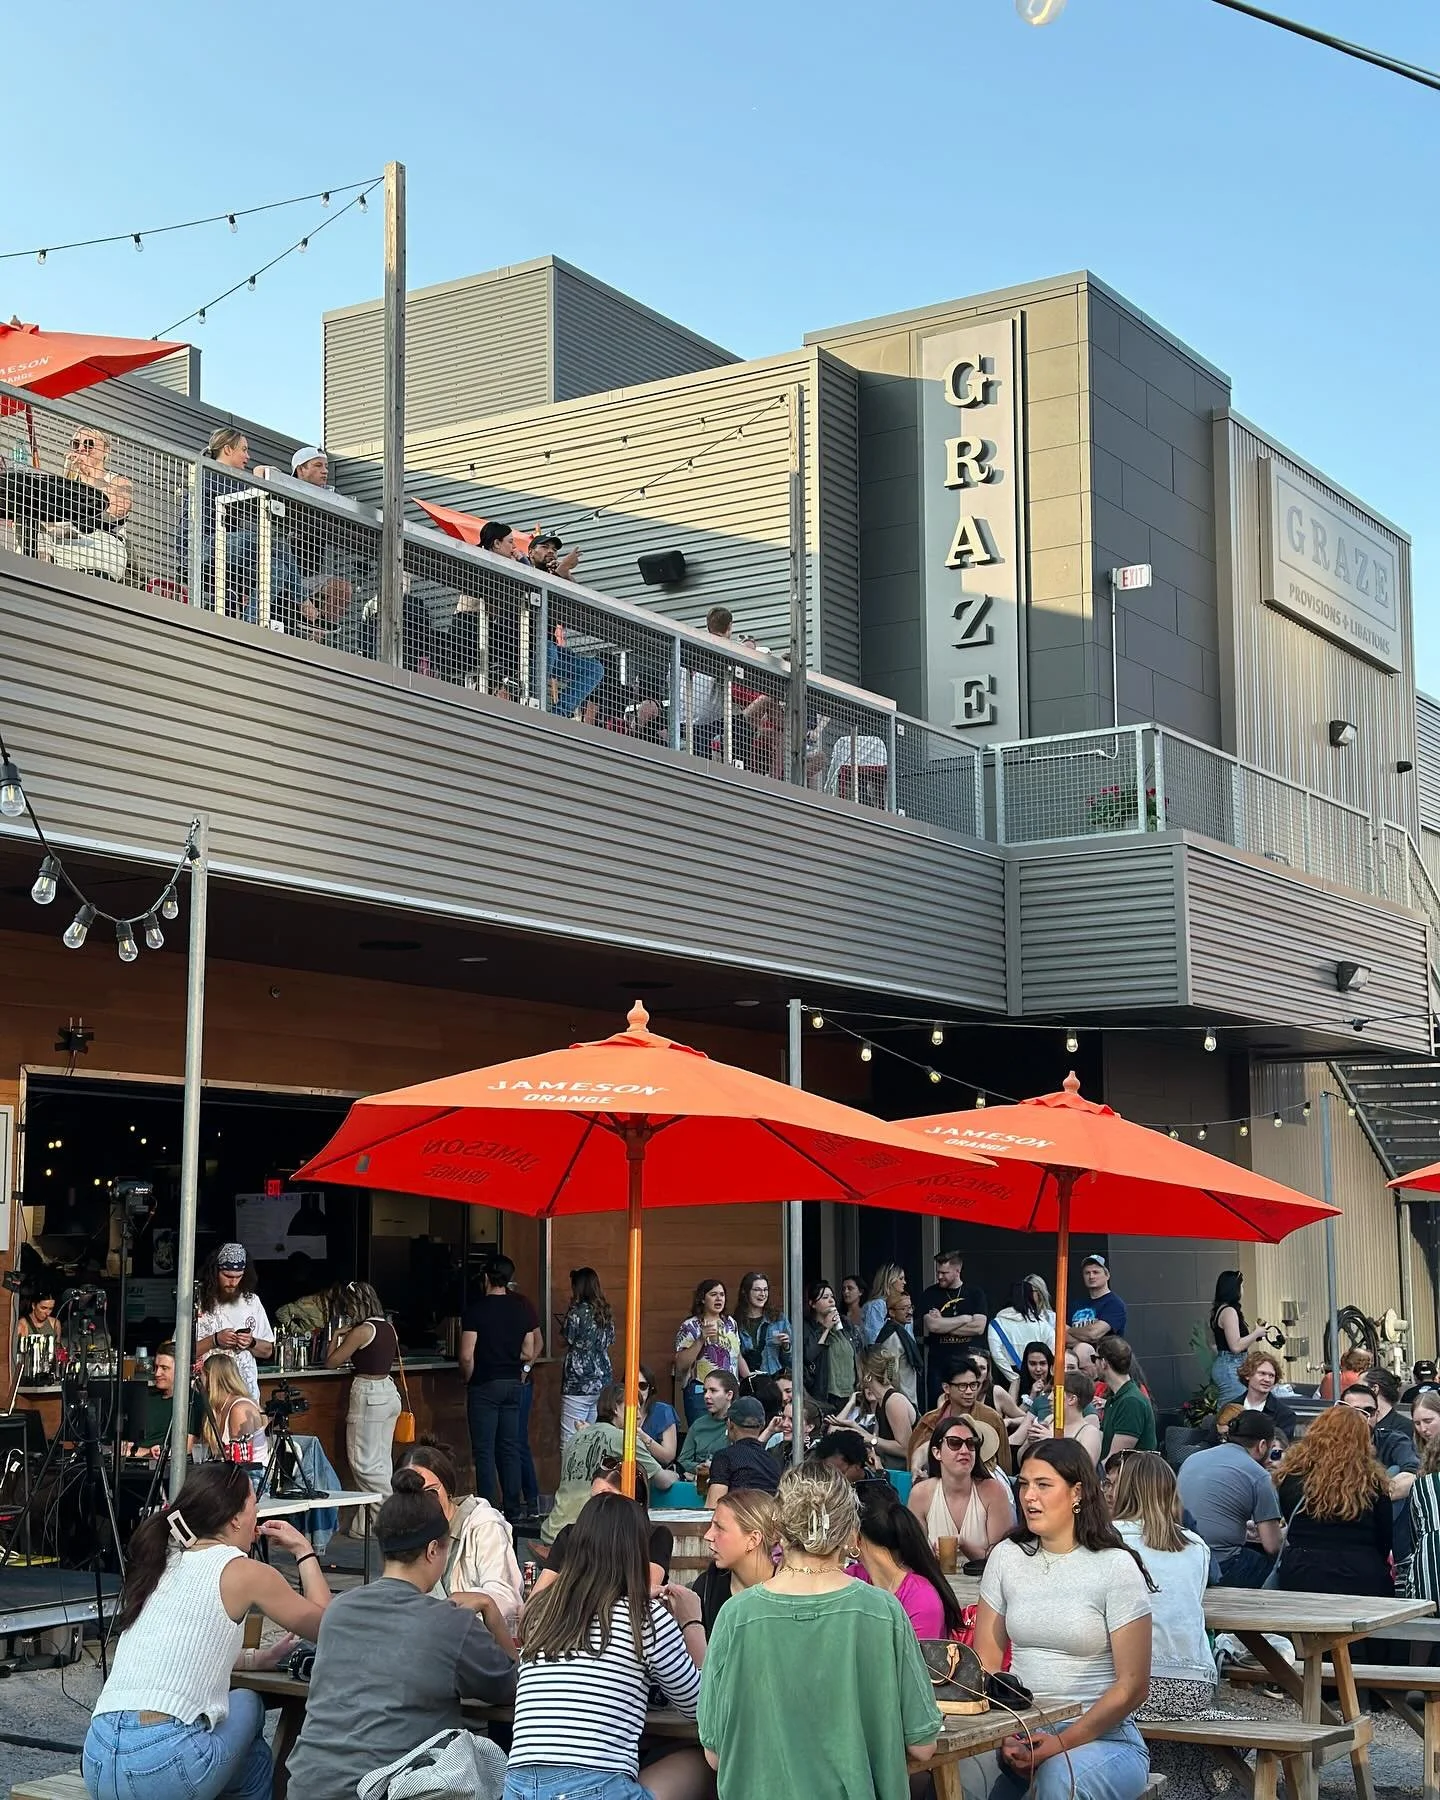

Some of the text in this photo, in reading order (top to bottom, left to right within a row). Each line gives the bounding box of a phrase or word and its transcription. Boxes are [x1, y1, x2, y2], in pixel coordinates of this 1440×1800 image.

[943, 352, 999, 727] GRAZE
[1287, 505, 1389, 608] GRAZE
[1122, 567, 1145, 587] EXIT
[1288, 582, 1341, 625] PROVISIONS
[1350, 618, 1390, 654] LIBATIONS
[487, 1080, 669, 1096] JAMESON
[522, 1093, 616, 1105] ORANGE
[924, 1126, 1055, 1149] JAMESON
[943, 1138, 1013, 1152] ORANGE
